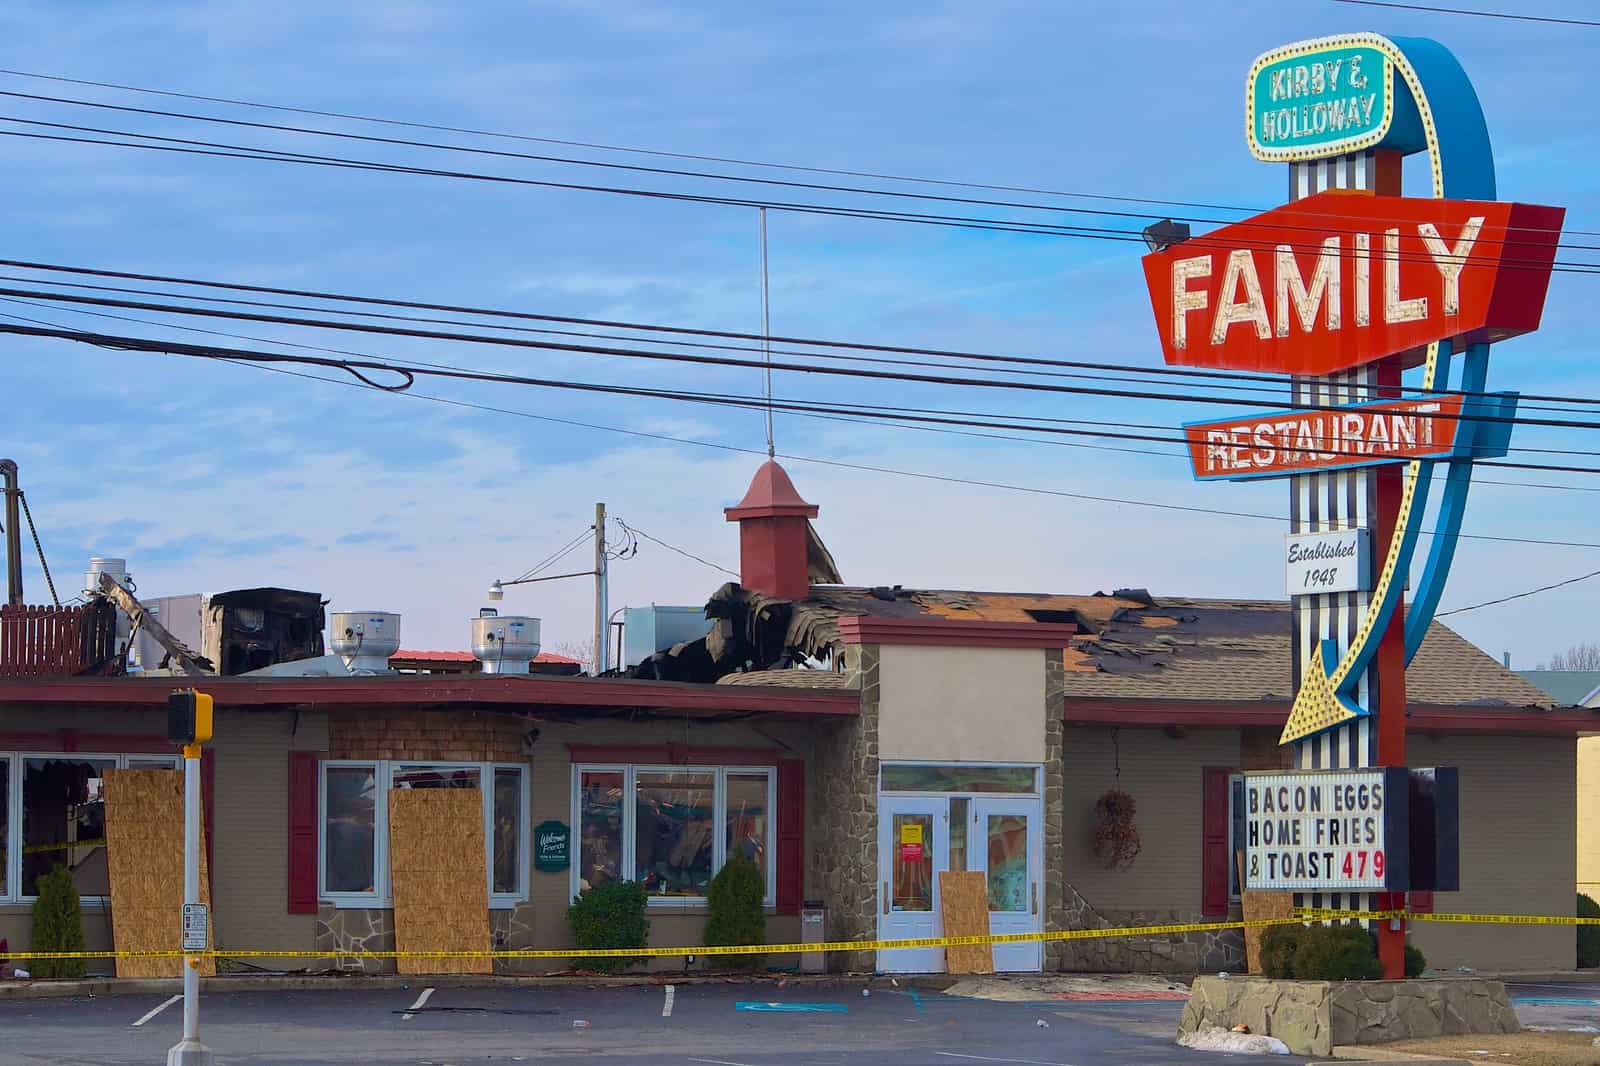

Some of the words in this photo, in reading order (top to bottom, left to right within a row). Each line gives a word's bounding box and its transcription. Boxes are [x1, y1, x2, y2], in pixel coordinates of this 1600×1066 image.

[1271, 58, 1343, 102] KIRBY
[1349, 54, 1368, 89] &
[1262, 92, 1377, 142] HOLLOWAY
[1171, 216, 1486, 351] FAMILY
[1206, 402, 1441, 472] RESTAURANT
[1287, 540, 1356, 564] Established
[1304, 567, 1338, 588] 1948
[1249, 785, 1321, 814] BACON
[1334, 783, 1382, 812] EGGS
[1249, 819, 1301, 847] HOME
[1315, 816, 1376, 846] FRIES
[1250, 854, 1259, 877] &
[1267, 851, 1335, 880] TOAST
[1342, 849, 1385, 879] 479
